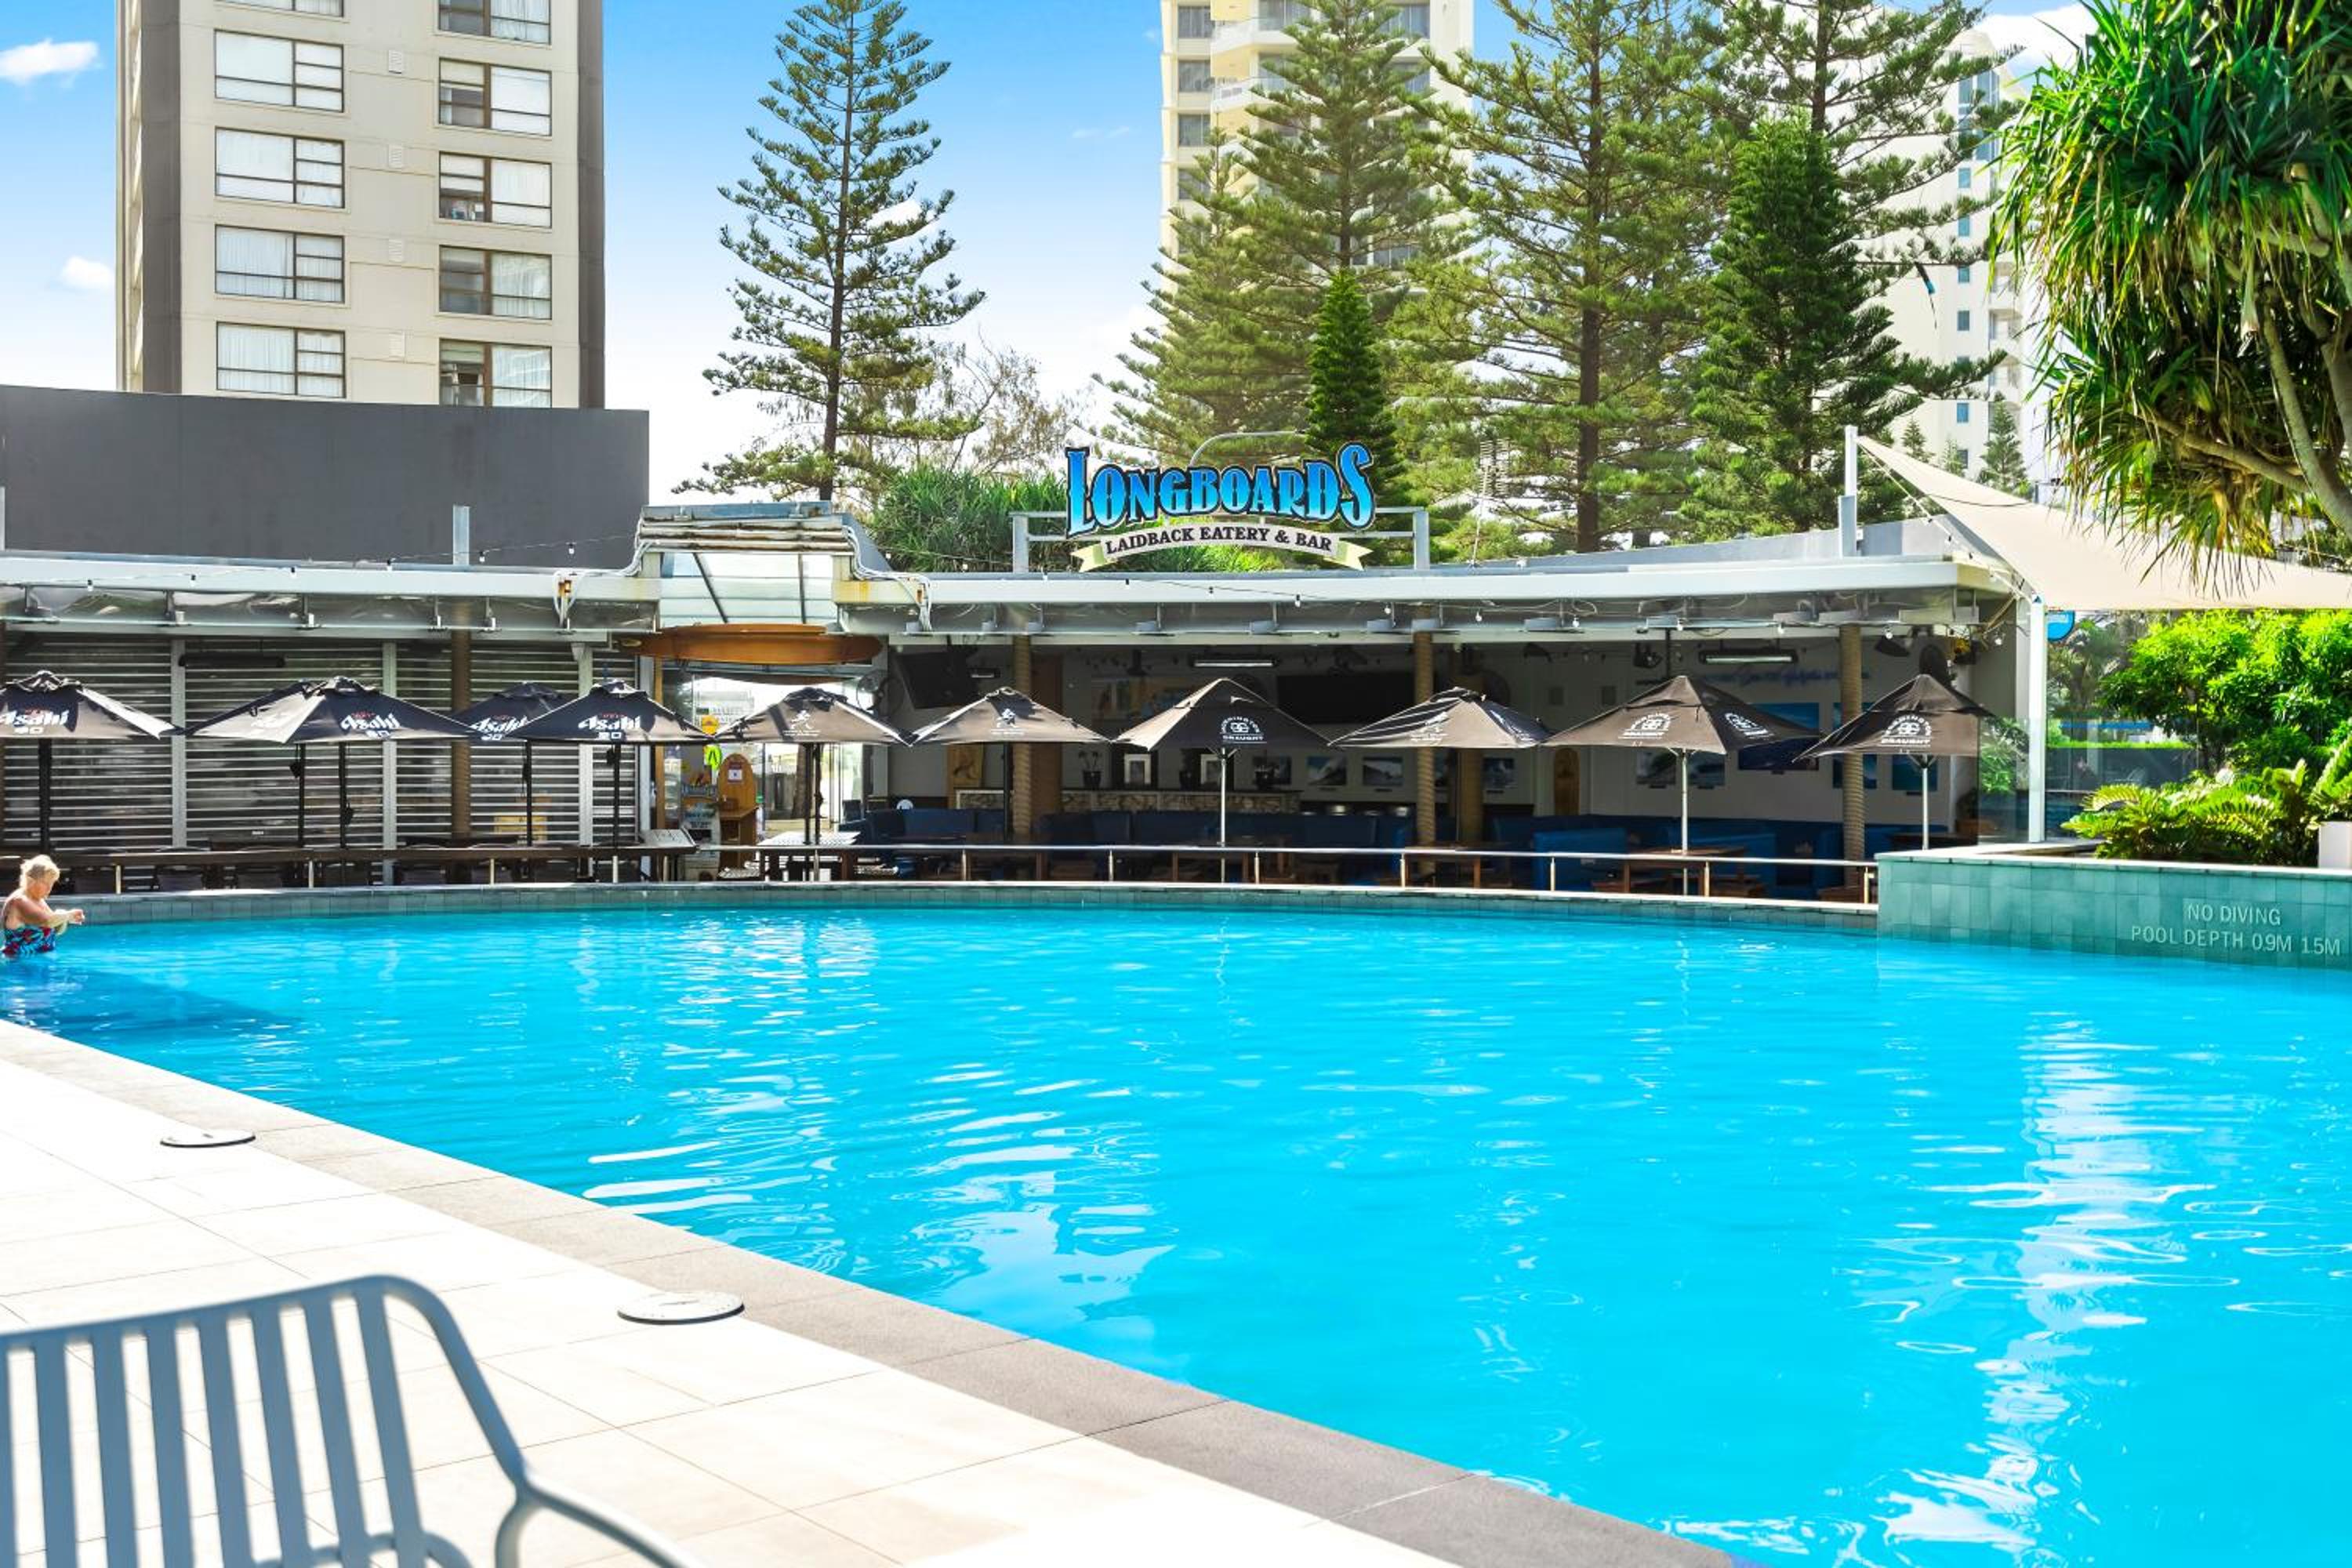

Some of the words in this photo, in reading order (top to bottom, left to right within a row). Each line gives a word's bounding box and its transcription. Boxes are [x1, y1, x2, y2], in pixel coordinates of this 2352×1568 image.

[1065, 441, 1376, 539] LONGBOARDS
[1105, 527, 1193, 555] LAIDBACK
[1200, 527, 1270, 543] EATERY
[1275, 529, 1290, 544] &
[1295, 531, 1333, 552] BAR
[340, 713, 401, 730] Asahi
[578, 714, 641, 730] Asahi
[2187, 904, 2213, 921] NO
[2220, 906, 2281, 926] DIVING
[2132, 925, 2179, 945] POOL
[2183, 928, 2244, 949] DEPTH
